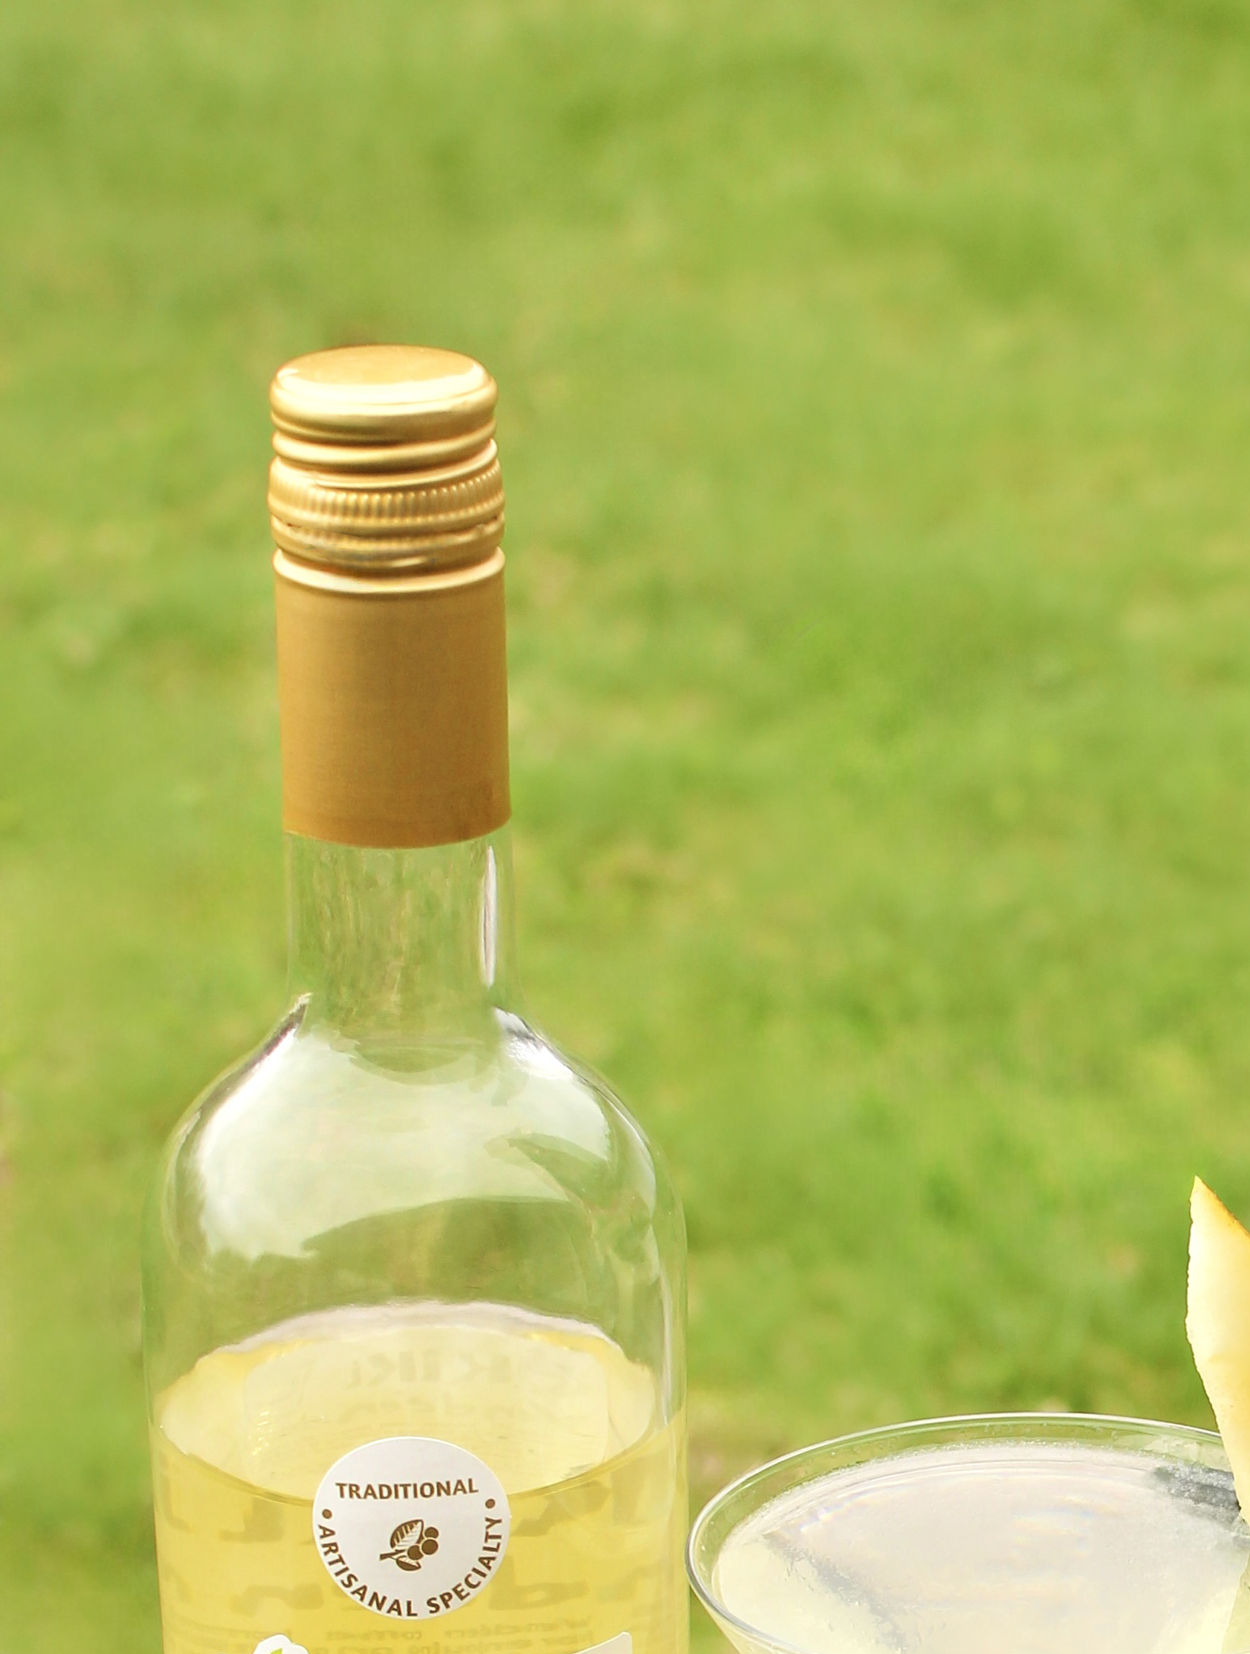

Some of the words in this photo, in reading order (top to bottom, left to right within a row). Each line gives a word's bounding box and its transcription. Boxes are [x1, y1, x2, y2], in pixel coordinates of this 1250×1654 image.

[335, 1478, 479, 1500] TRADITIONAL
[318, 1524, 418, 1617] ARTISANAL
[426, 1516, 502, 1615] SPECIALTY
